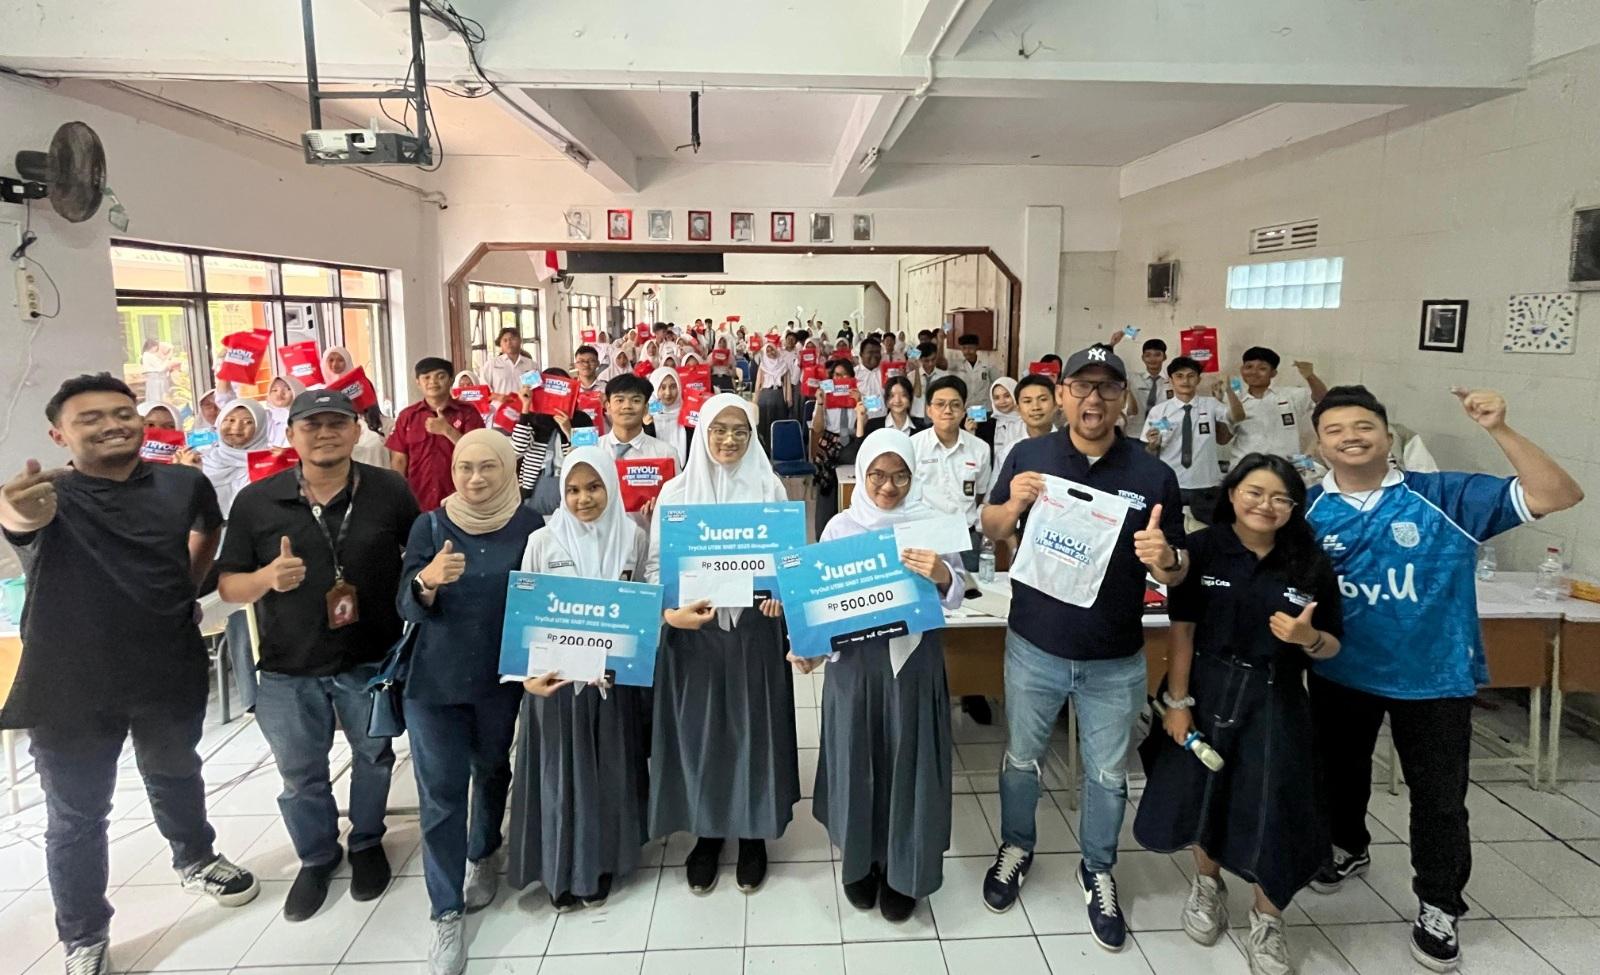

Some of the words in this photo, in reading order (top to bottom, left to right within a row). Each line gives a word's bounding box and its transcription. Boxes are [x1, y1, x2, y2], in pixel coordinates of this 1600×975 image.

[1088, 348, 1106, 361] NY
[627, 465, 659, 475] TRYOUT
[1118, 490, 1146, 502] TRYOUT
[700, 526, 754, 541] Juara
[757, 524, 769, 539] 2
[1043, 528, 1093, 556] TRYOUT
[1054, 542, 1076, 556] SNBT
[702, 561, 712, 570] Rp
[713, 560, 765, 571] 300.000
[821, 558, 876, 581] Juara
[878, 553, 888, 568] 1
[1337, 562, 1418, 606] by.U
[547, 599, 605, 617] Juara
[608, 603, 620, 618] 3
[827, 602, 839, 612] Rp
[840, 590, 894, 611] 500.000
[547, 633, 558, 643] Rp
